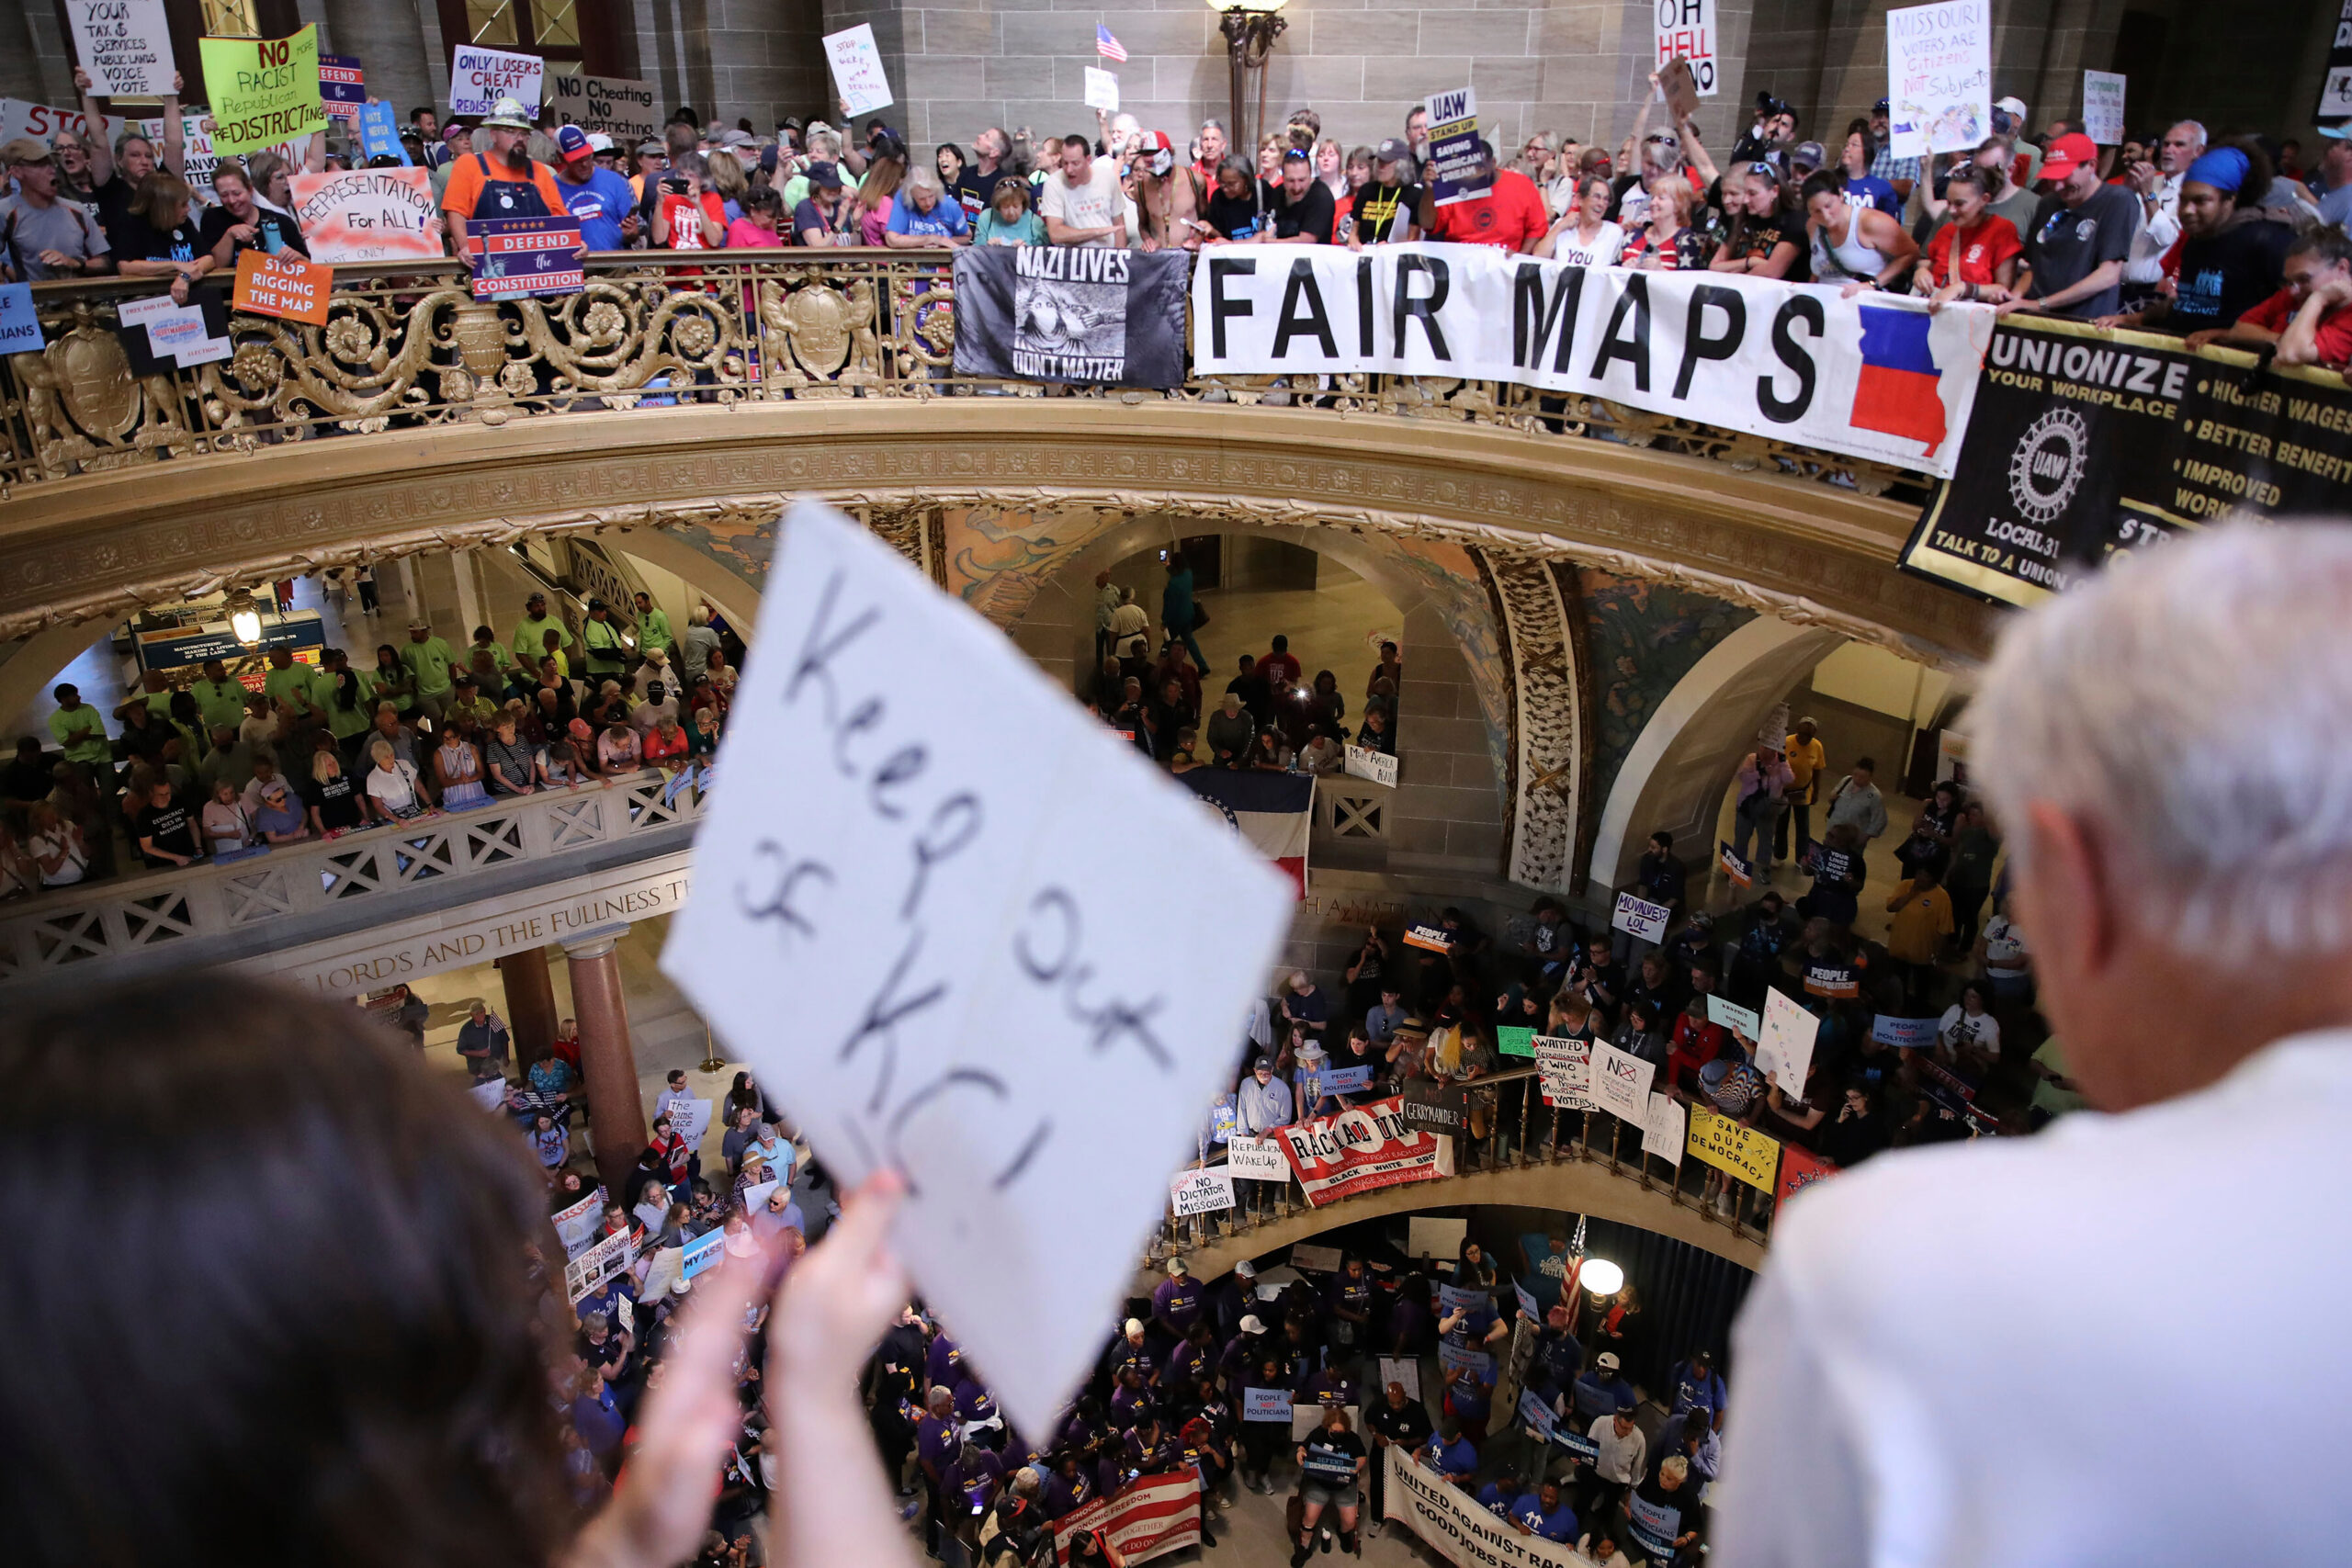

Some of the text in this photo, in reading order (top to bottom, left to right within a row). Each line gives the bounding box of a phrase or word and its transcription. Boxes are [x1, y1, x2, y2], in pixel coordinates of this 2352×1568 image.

[85, 2, 130, 21] YOUR
[1659, 0, 1701, 28] OH
[85, 22, 127, 38] TAX $
[1894, 6, 1982, 39] MISSOURI
[93, 39, 147, 53] SERVICES
[258, 39, 314, 69] NO MORE
[1659, 28, 1712, 64] HELL
[1902, 30, 1977, 58] VOTERS ARE
[94, 53, 157, 66] PUBLIC LANDS
[459, 55, 541, 75] ONLY LOSERS
[102, 67, 145, 80] VOICE
[236, 62, 298, 93] RACIST
[319, 69, 356, 82] EFEND
[471, 72, 524, 89] CHEAT
[110, 81, 149, 93] VOTE
[483, 87, 505, 100] NO
[557, 77, 652, 107] NO Cheating
[220, 89, 298, 115] Republican
[589, 99, 612, 117] NO
[1433, 92, 1466, 121] UAW
[561, 113, 653, 136] Redistricting
[1431, 120, 1475, 140] STAND UP
[1436, 140, 1472, 157] SAVING
[1442, 166, 1476, 183] DREAM
[300, 174, 436, 225] REPRESENTATION
[356, 245, 386, 258] ONLY
[503, 234, 570, 250] DEFEND
[266, 258, 306, 276] STOP
[1016, 246, 1131, 283] NAZI LIVES
[1567, 249, 1594, 265] YOU
[252, 272, 314, 297] RIGGING
[477, 273, 582, 292] CONSTITUTION
[250, 289, 277, 306] THE
[281, 296, 313, 312] MAP
[1208, 254, 1825, 423] FAIR MAPS
[1061, 355, 1125, 381] MATTER
[1992, 333, 2189, 400] UNIONIZE
[1988, 368, 2177, 421] YOUR WORKPLACE
[2196, 420, 2272, 458] BETTER
[2033, 450, 2069, 482] UAW
[2182, 459, 2281, 507] IMPROVED
[1936, 530, 2067, 591] TALK TO A UNION
[784, 564, 985, 920] Keep
[161, 819, 175, 829] DIES
[1414, 925, 1448, 942] PEOPLE
[1627, 916, 1649, 932] LOL
[319, 950, 413, 992] LORD'S
[423, 933, 486, 967] AND
[490, 919, 543, 948] THE
[550, 888, 662, 933] FULLNESS
[1012, 887, 1176, 1073] Out
[1811, 966, 1849, 982] PEOPLE
[1722, 1003, 1748, 1018] RESPECT
[1725, 1014, 1747, 1029] VOTERS
[1890, 1021, 1926, 1030] PEOPLE
[1536, 1038, 1582, 1052] WANTED
[1331, 1071, 1358, 1079] PEOPLE
[1548, 1060, 1576, 1072] WHO
[553, 1104, 570, 1120] DECADE
[671, 1101, 690, 1110] the
[1406, 1102, 1460, 1126] GERRYMANDER
[1290, 1120, 1372, 1159] RACIAL
[1717, 1120, 1750, 1141] SAVE
[1647, 1131, 1674, 1155] HELL
[1713, 1133, 1744, 1152] OUR
[1330, 1150, 1412, 1173] WE WON'T FIGHT EACH
[1691, 1134, 1764, 1180] DEMOCRACY
[1329, 1160, 1404, 1184] BLACK WHITE
[1180, 1183, 1226, 1201] DICTATOR
[1195, 1177, 1211, 1189] NO
[1315, 1170, 1408, 1201] WE FIGHT WAGE SLAVERY
[553, 1192, 601, 1226] MISSING
[1180, 1196, 1230, 1214] MISSOURI
[581, 1235, 619, 1262] ONE-PARTY
[684, 1244, 722, 1269] MY ASS
[593, 1275, 608, 1289] WITH
[609, 1263, 626, 1278] THEM
[1247, 1407, 1290, 1416] POLITICIANS
[1531, 1396, 1550, 1420] PEOPLE
[1561, 1429, 1588, 1445] DEFEND
[1309, 1462, 1351, 1473] DEMOCRACY
[1068, 1493, 1151, 1540] ECONOMIC FREEDOM
[1394, 1461, 1525, 1558] UNITED AGAINST
[1639, 1503, 1666, 1520] PEOPLE
[1643, 1513, 1659, 1525] NOT
[1124, 1521, 1164, 1537] TOGETHER
[1416, 1501, 1498, 1567] GOOD JOBS
